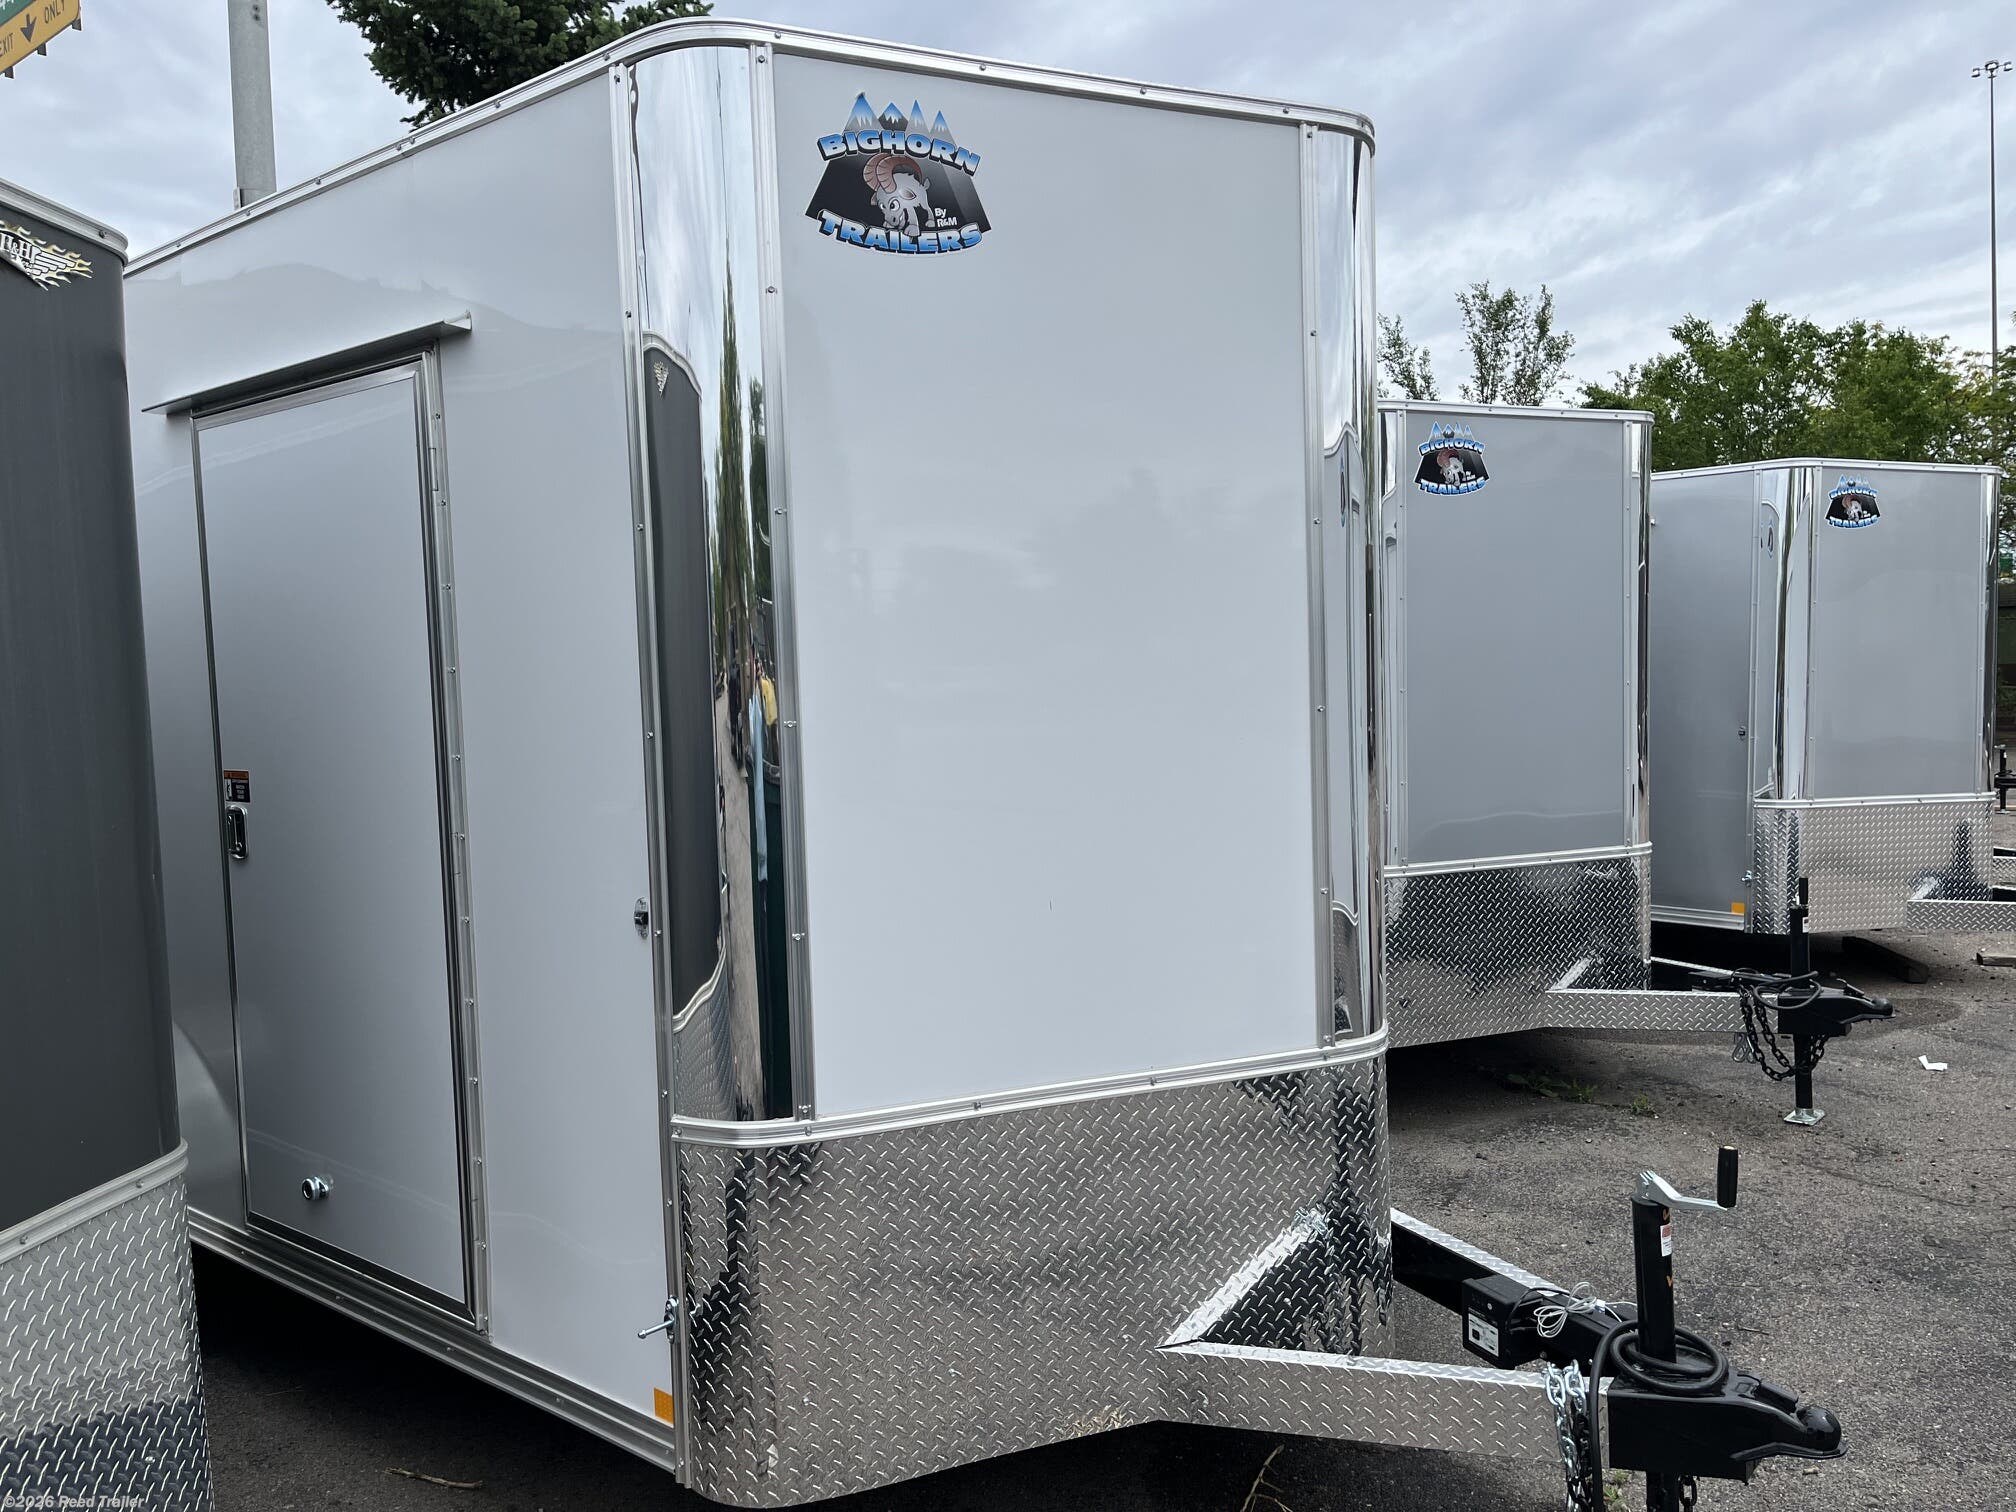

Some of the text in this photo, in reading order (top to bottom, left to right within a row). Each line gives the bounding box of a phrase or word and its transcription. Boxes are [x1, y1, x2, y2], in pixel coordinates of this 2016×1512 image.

[44, 0, 65, 24] ONLY
[817, 129, 982, 177] BIGHORN
[934, 207, 947, 219] By
[937, 216, 958, 227] R&M
[817, 209, 983, 255] TRAILERS
[1418, 438, 1486, 456] BIGHORN
[1420, 477, 1487, 495] TRAILERS
